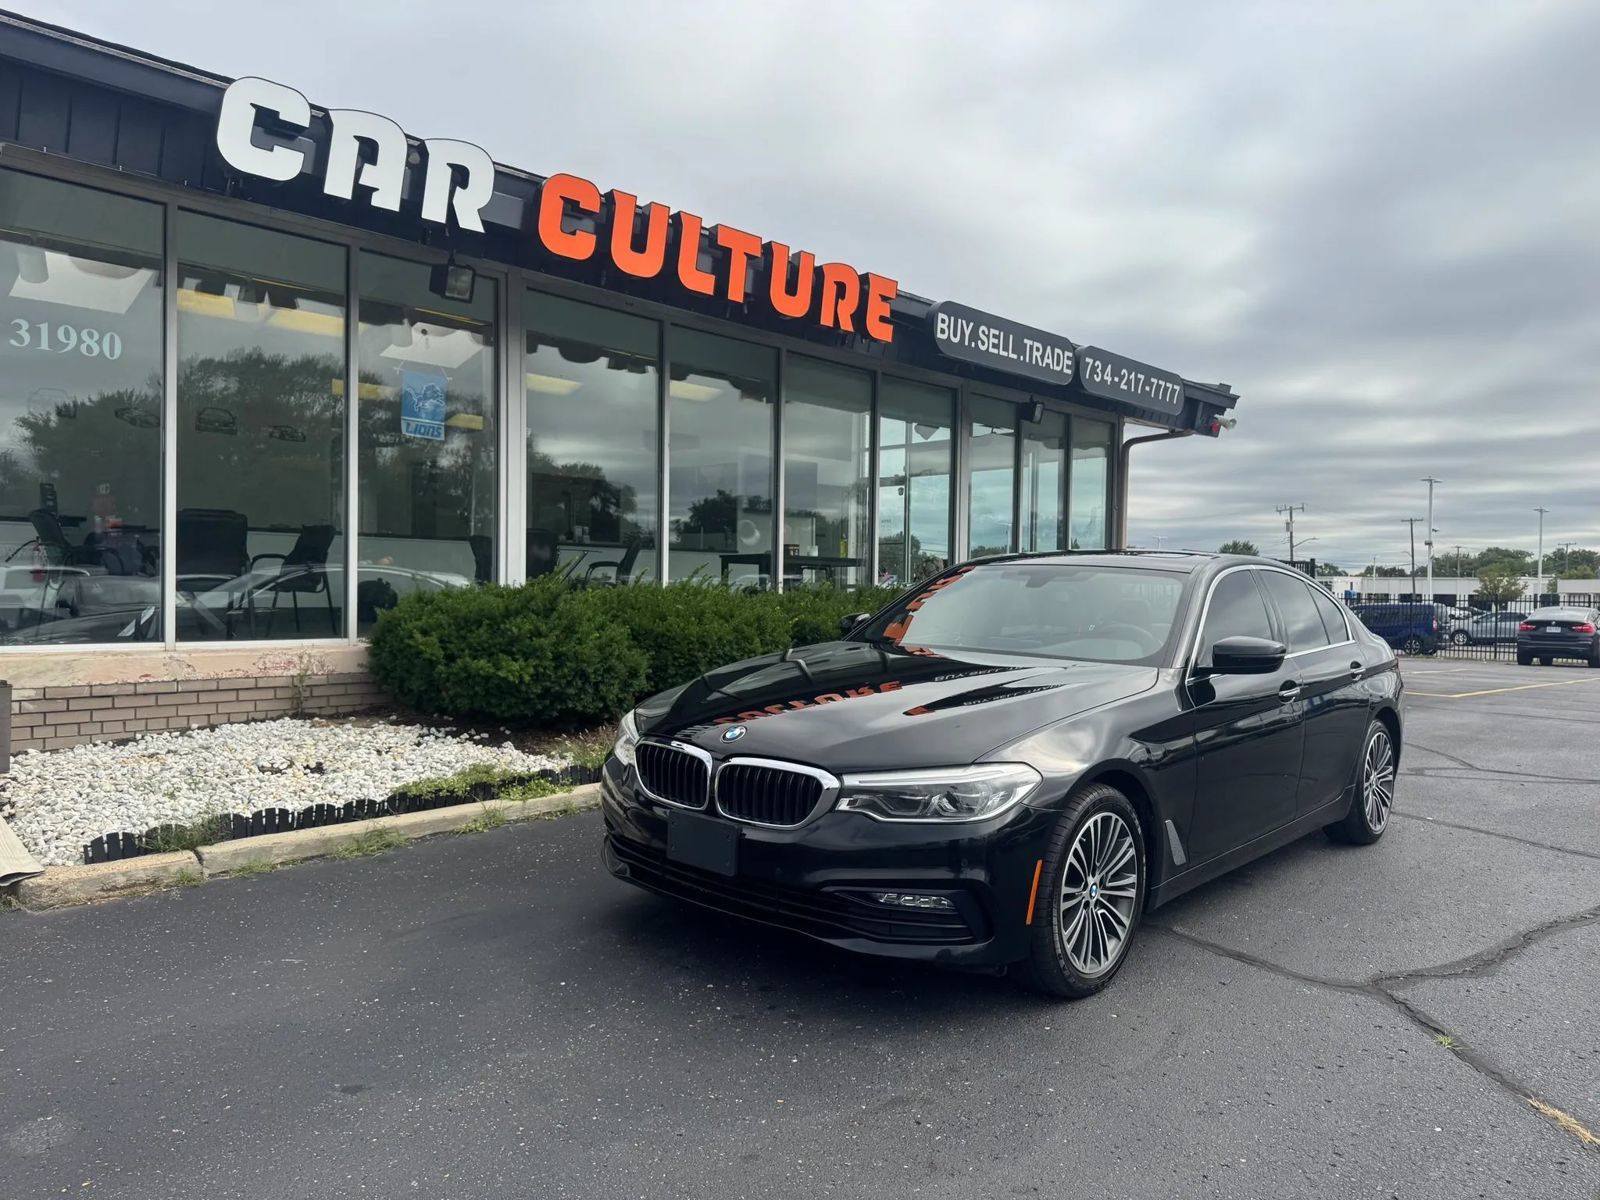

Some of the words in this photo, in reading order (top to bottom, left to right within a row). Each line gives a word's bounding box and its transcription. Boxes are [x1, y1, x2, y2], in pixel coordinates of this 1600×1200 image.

[217, 77, 495, 233] CAR
[538, 173, 898, 342] CULTURE
[9, 318, 122, 360] 31980
[1084, 357, 1181, 405] 734-217-7777
